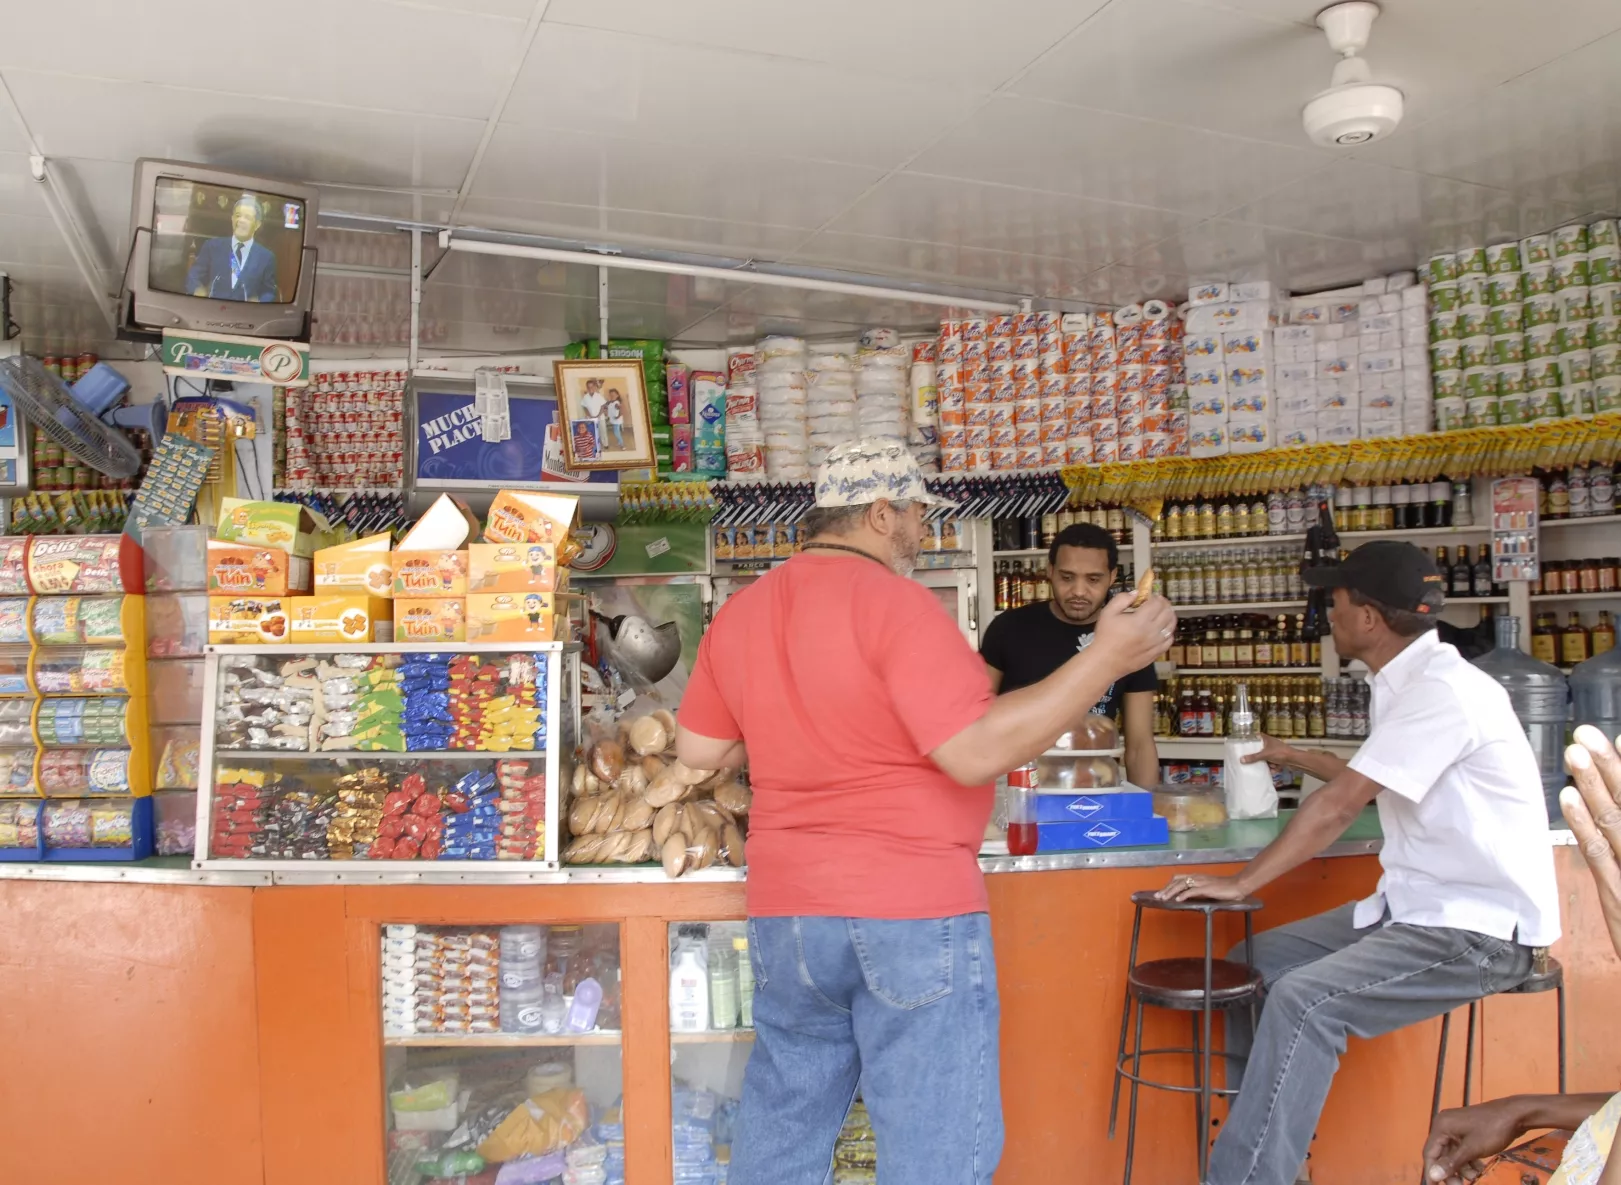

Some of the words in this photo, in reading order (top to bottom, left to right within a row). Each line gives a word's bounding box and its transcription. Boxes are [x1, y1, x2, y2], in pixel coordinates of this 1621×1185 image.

[421, 402, 480, 439] MUCH
[428, 419, 483, 455] PLACE
[34, 541, 78, 557] Delis
